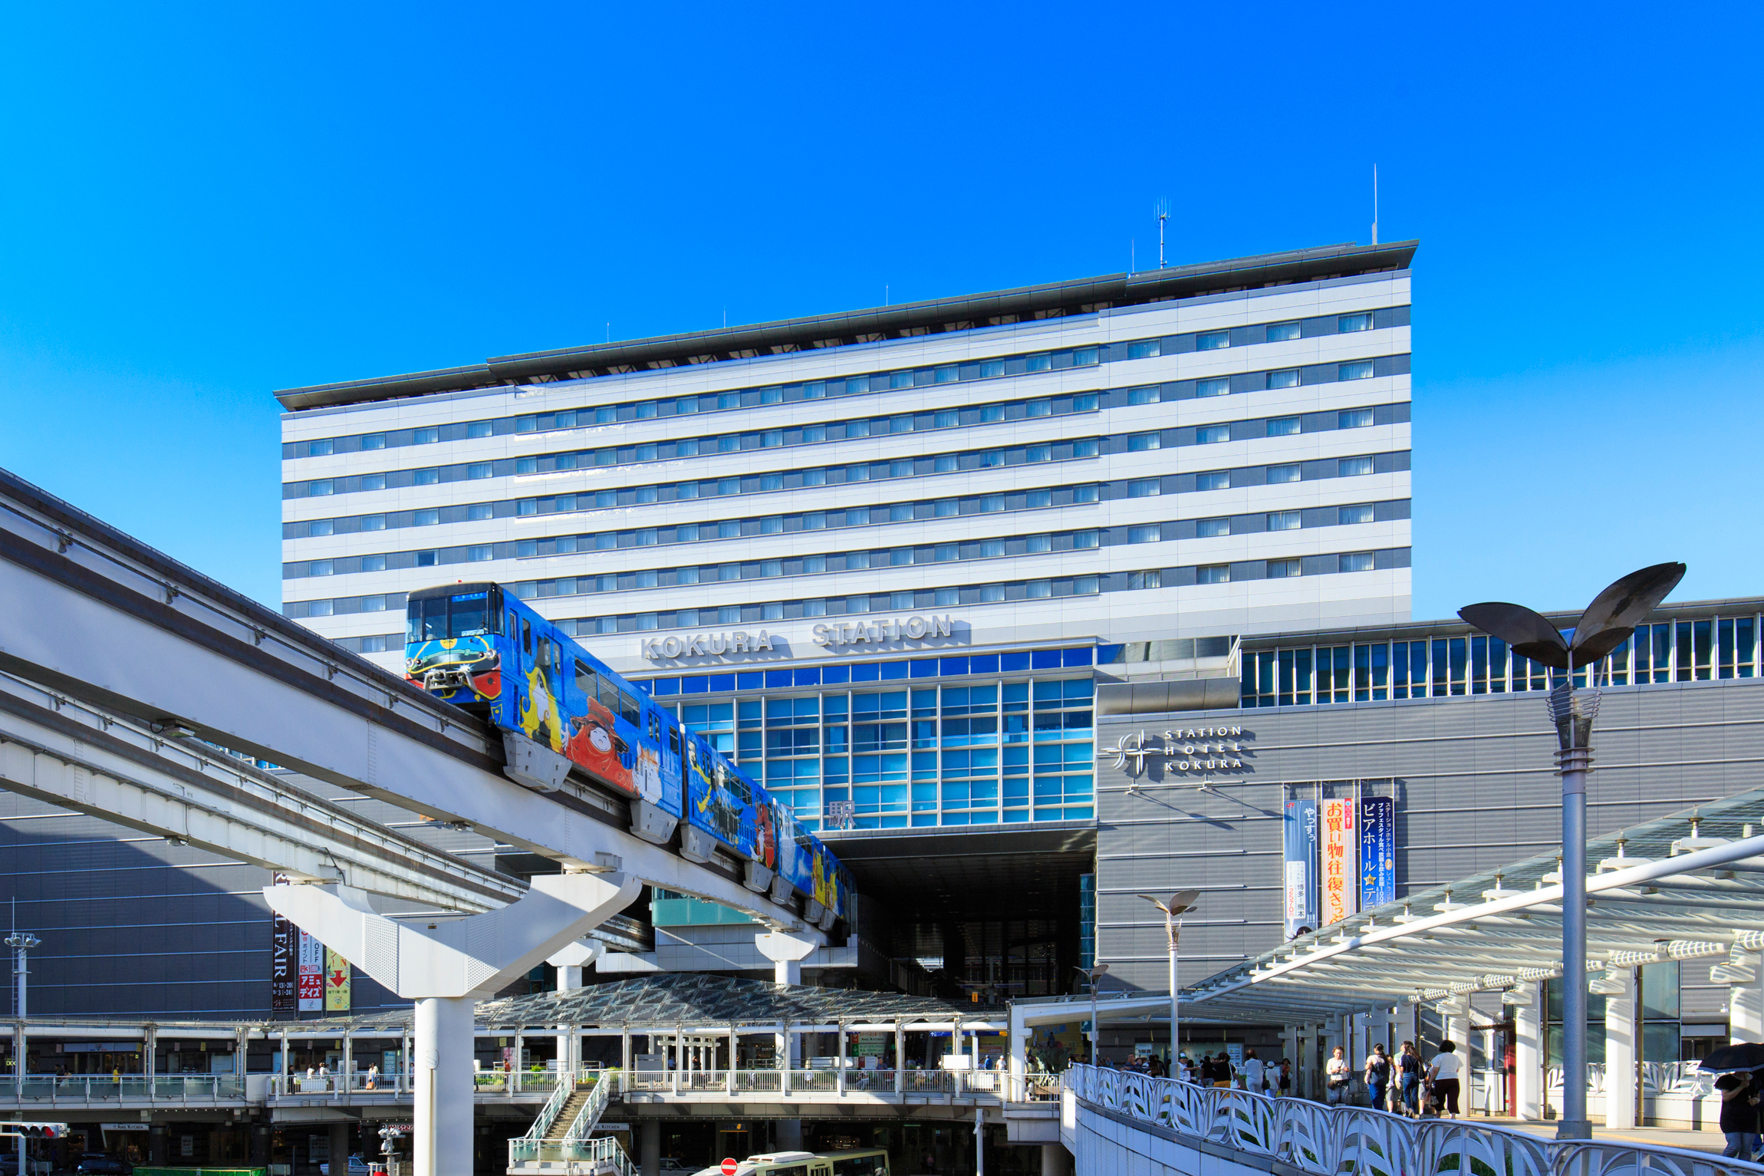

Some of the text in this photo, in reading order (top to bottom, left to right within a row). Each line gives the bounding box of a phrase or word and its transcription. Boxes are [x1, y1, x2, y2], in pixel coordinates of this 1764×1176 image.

[640, 614, 951, 660] KOKURA STATION
[1165, 726, 1242, 740] STATION
[1165, 742, 1242, 756] HOTEL
[1165, 759, 1242, 772] KOKURA
[828, 800, 858, 828] 駅
[275, 933, 286, 978] FAIR
[301, 975, 321, 985] アミュ
[300, 986, 322, 998] デイズ
